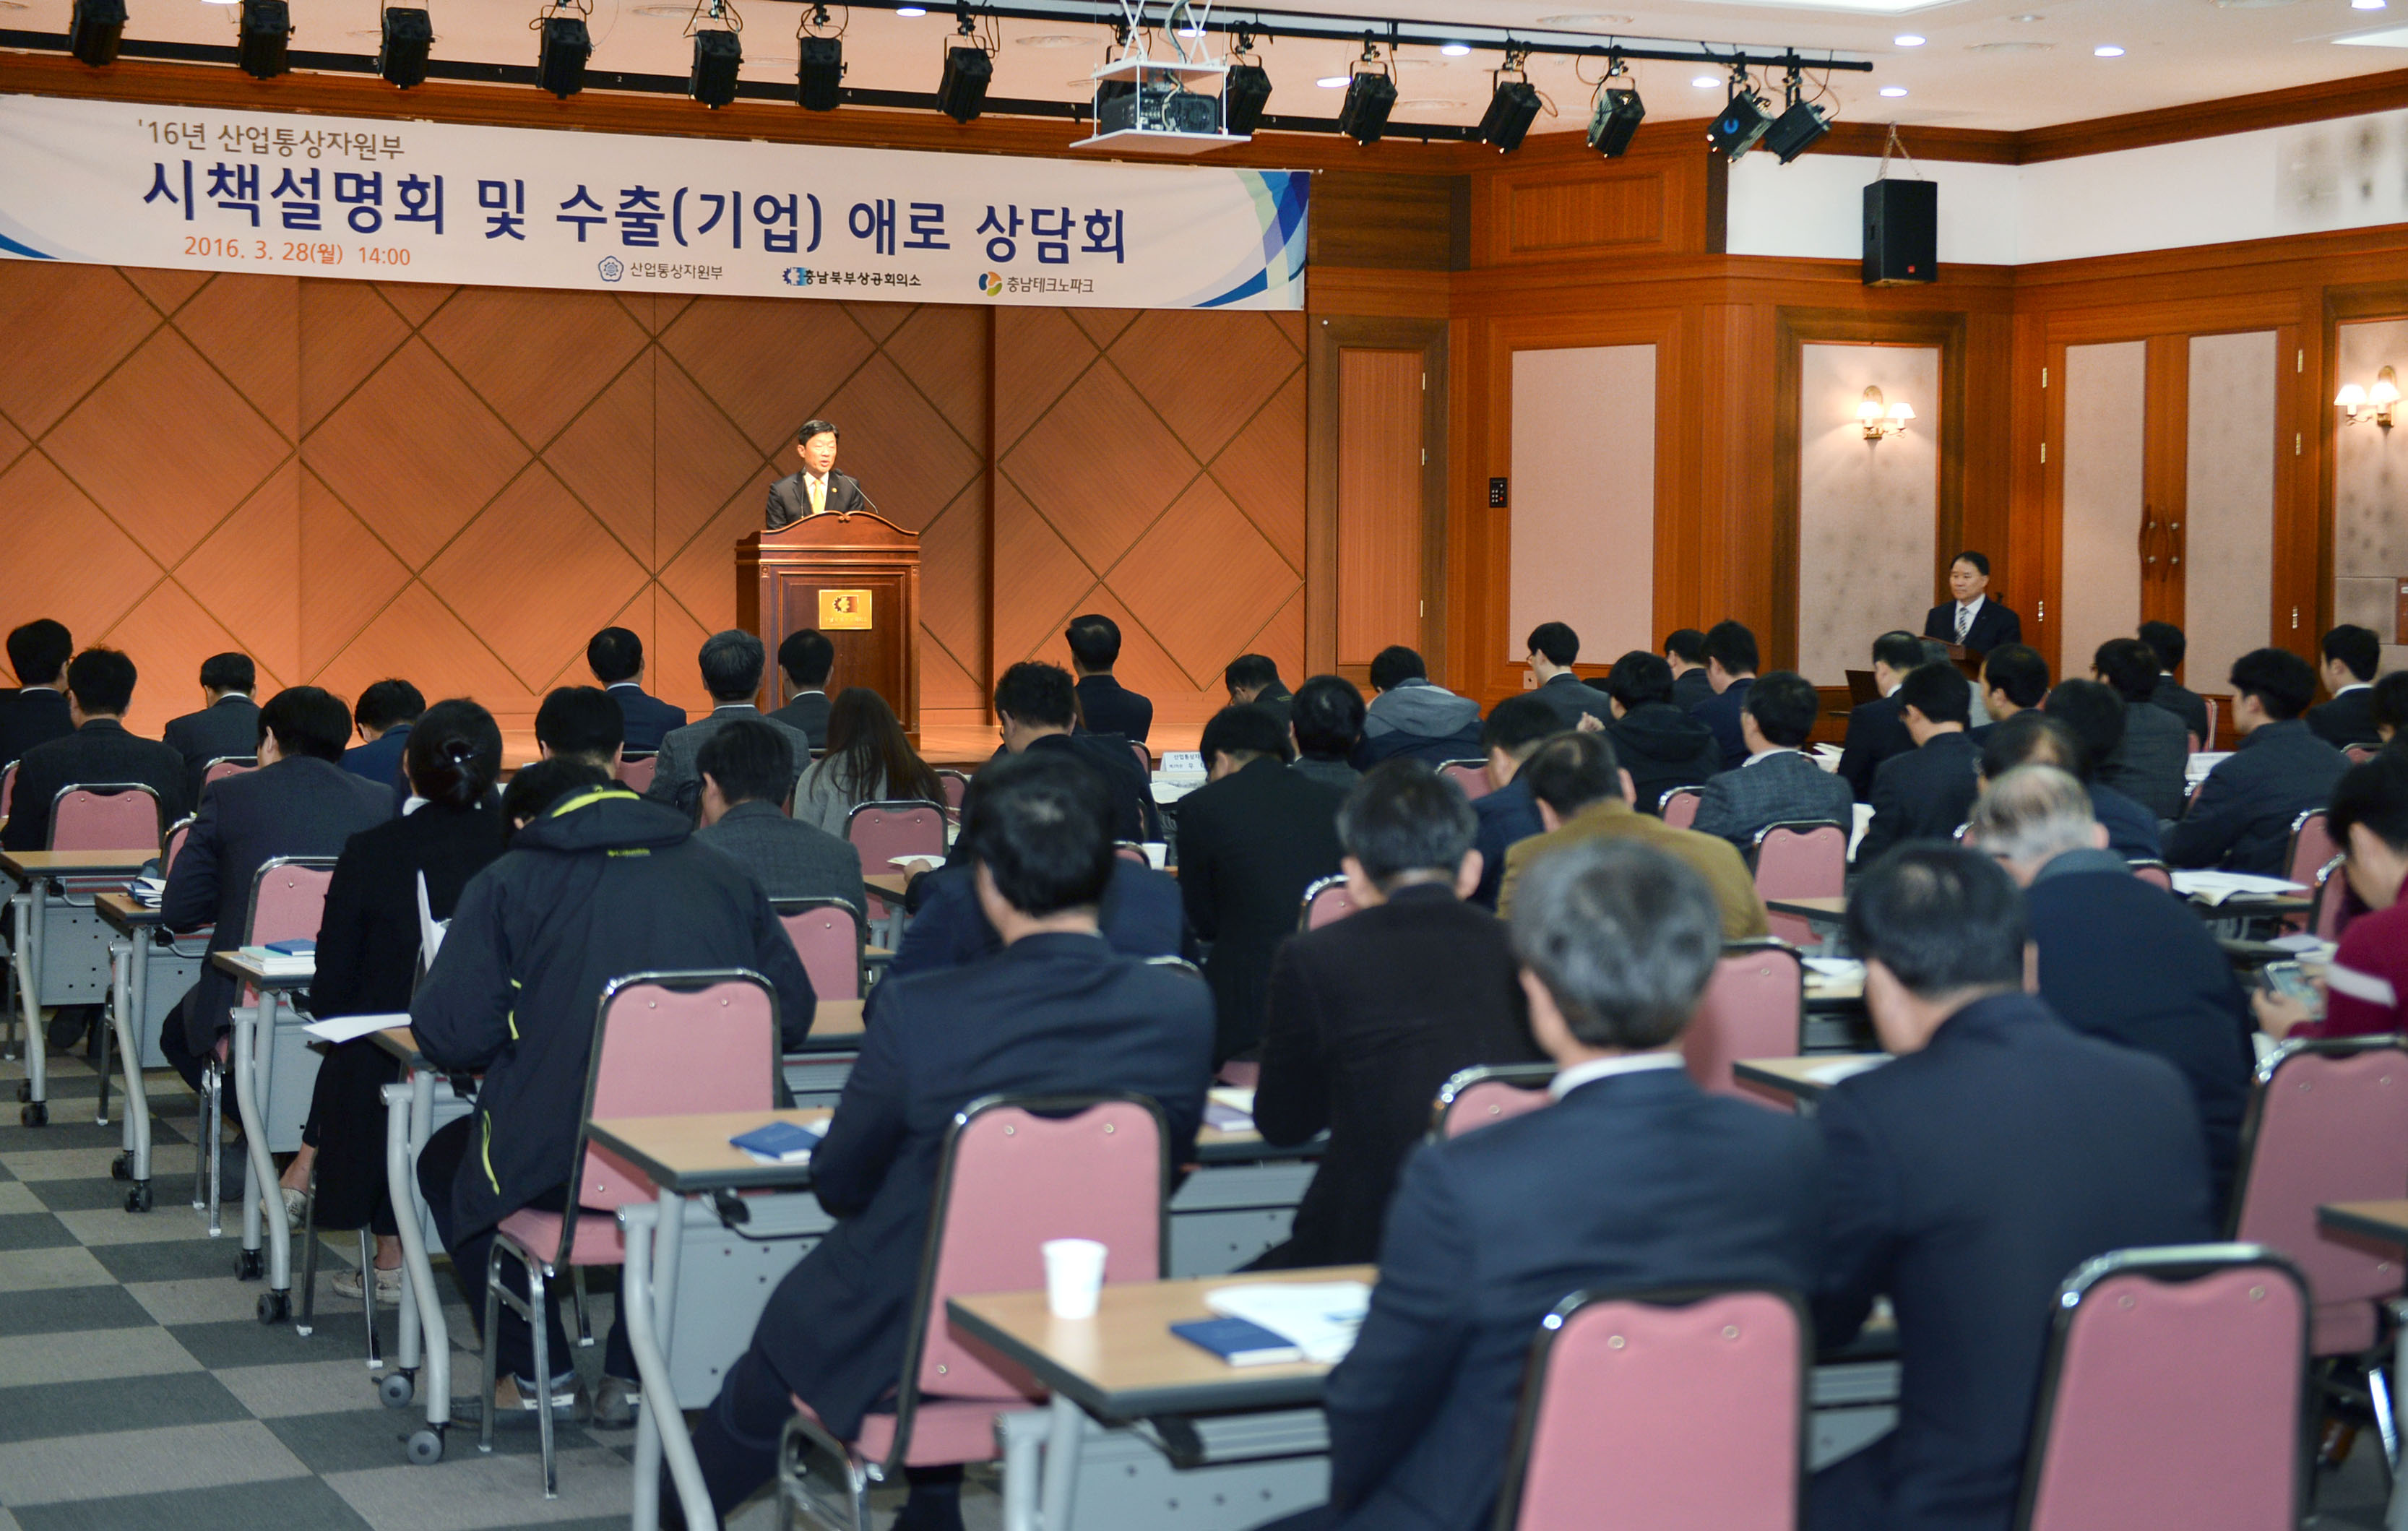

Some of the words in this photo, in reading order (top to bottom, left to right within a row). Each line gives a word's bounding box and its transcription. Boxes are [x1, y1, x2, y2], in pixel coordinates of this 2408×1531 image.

[138, 118, 206, 150] '16년
[217, 124, 405, 161] 산업통상자원부
[142, 159, 444, 236] 시책설명회
[478, 178, 527, 241] 및
[556, 184, 822, 254] 수출(기업)
[848, 199, 951, 256] 애로
[976, 204, 1125, 264] 상담회
[184, 236, 245, 259] 2016.
[254, 240, 272, 261] 3.
[282, 242, 343, 265] 28(월)
[358, 246, 411, 266] 14:00
[630, 262, 723, 280] 산업통상자원부
[803, 269, 922, 287] 충남북부상공회의소
[1007, 277, 1095, 294] 충남테크노파크
